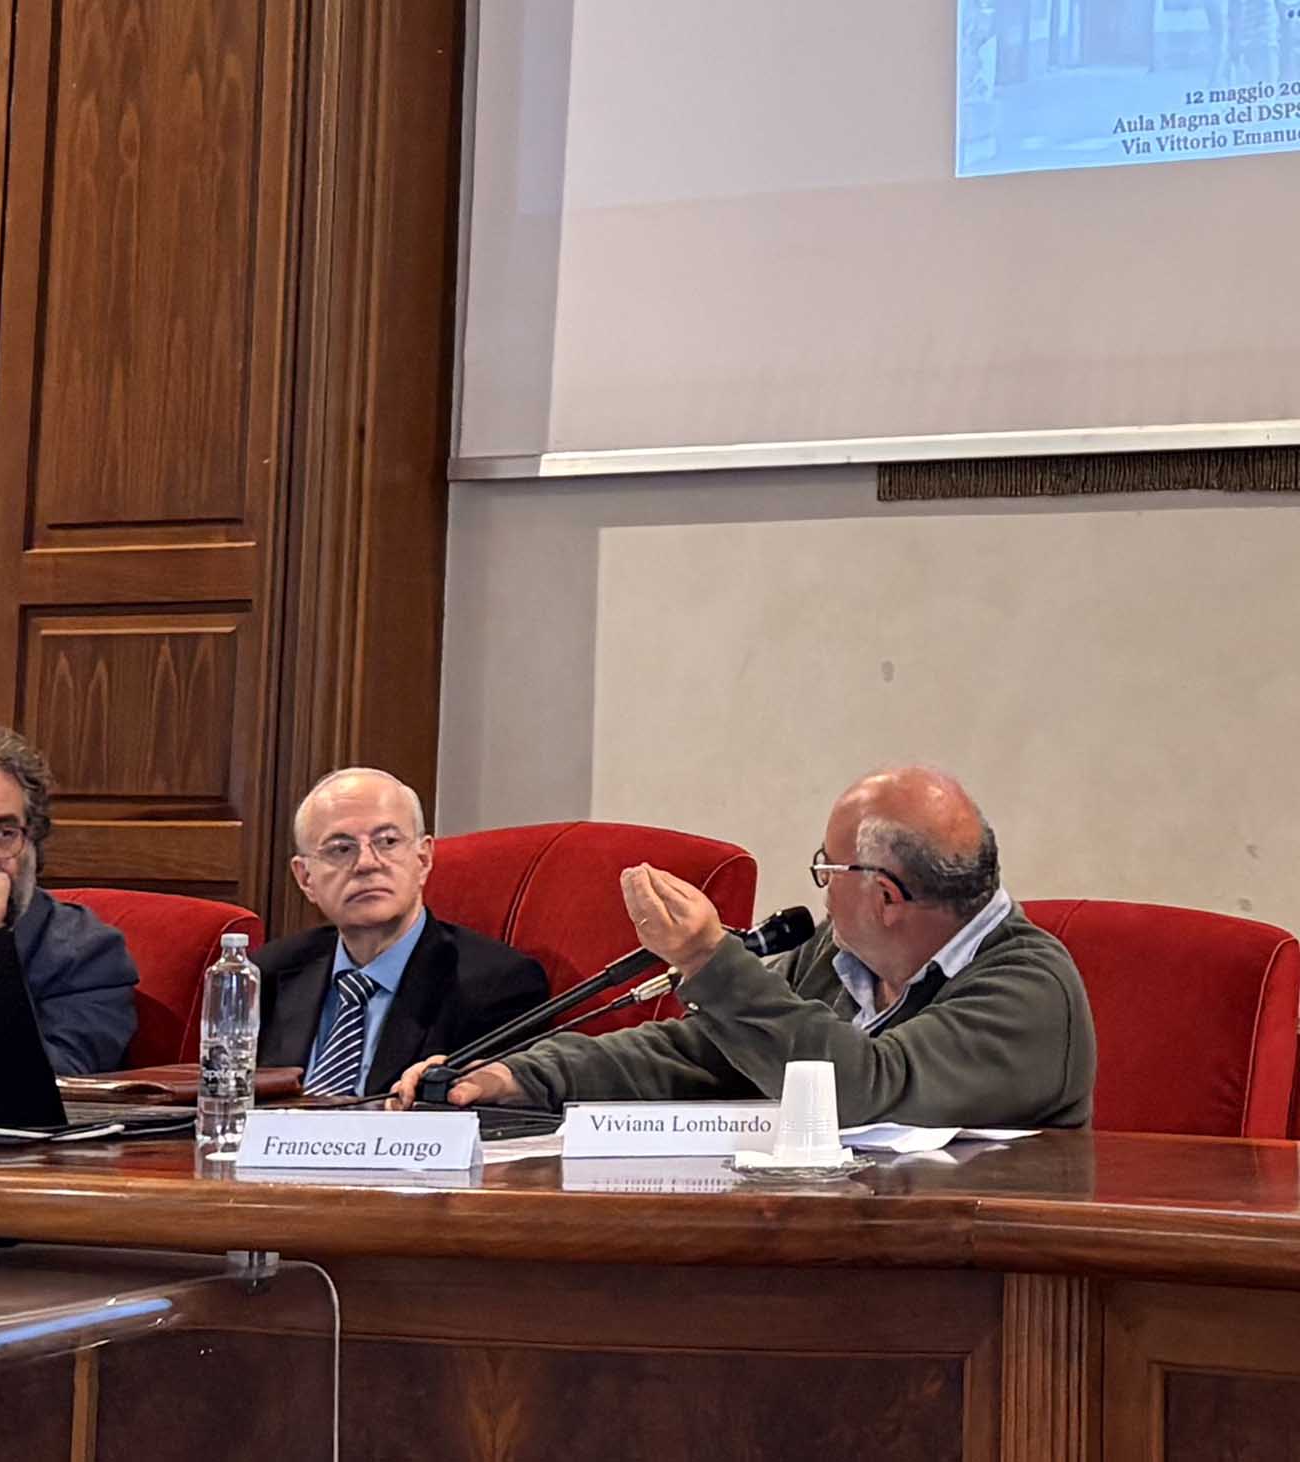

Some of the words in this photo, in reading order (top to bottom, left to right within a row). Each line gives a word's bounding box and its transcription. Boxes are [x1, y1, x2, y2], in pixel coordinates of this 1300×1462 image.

[1185, 91, 1204, 105] 12
[1209, 81, 1275, 104] maggio
[1112, 115, 1155, 134] Aula
[1160, 112, 1221, 132] Magna
[1225, 107, 1253, 124] del
[1122, 138, 1152, 155] Via
[1156, 131, 1228, 153] Vittorio
[1233, 128, 1300, 147] Emanu
[590, 1114, 665, 1133] Viviana
[672, 1114, 772, 1133] Lombardo
[263, 1135, 367, 1156] Francesca
[374, 1136, 442, 1162] Longo
